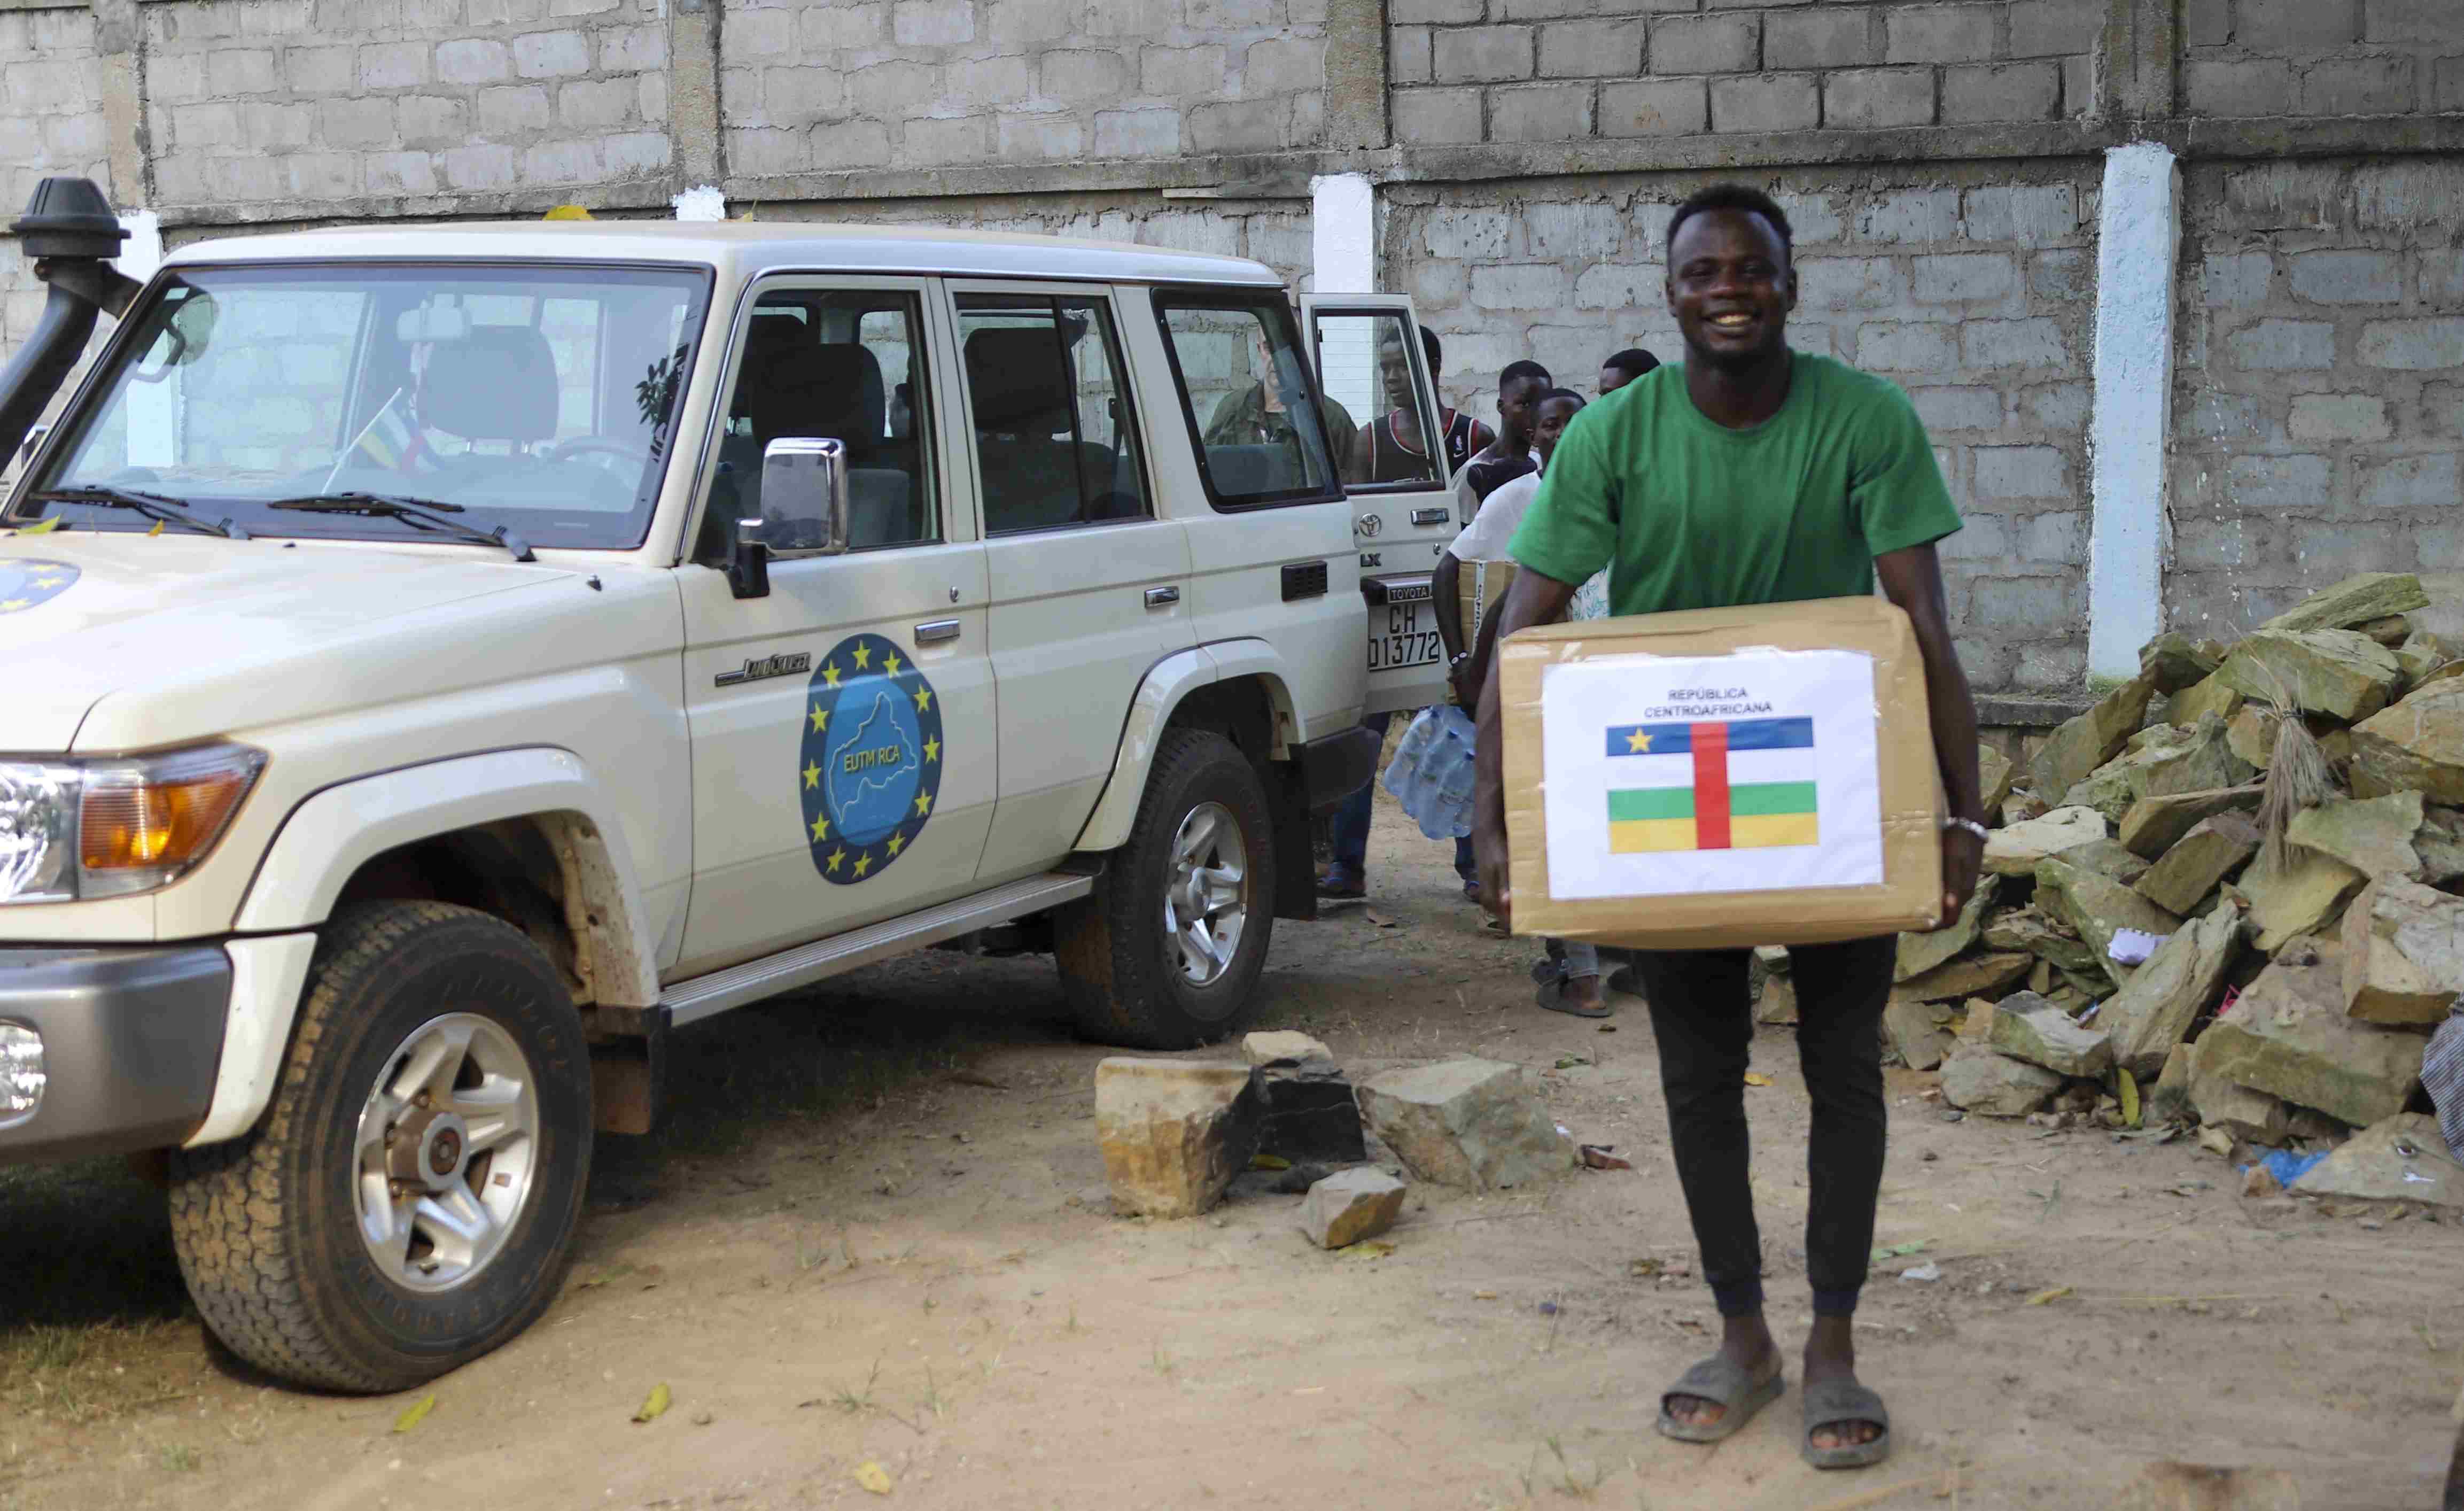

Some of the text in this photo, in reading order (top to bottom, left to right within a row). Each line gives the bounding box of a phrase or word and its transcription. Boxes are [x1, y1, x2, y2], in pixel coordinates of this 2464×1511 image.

[1392, 588, 1427, 600] TOYOTA
[1390, 605, 1416, 634] CH
[1668, 686, 1748, 701] REPÚBLICA
[1644, 701, 1773, 718] CENTROAFRICANA
[844, 745, 900, 772] EUTM RCA
